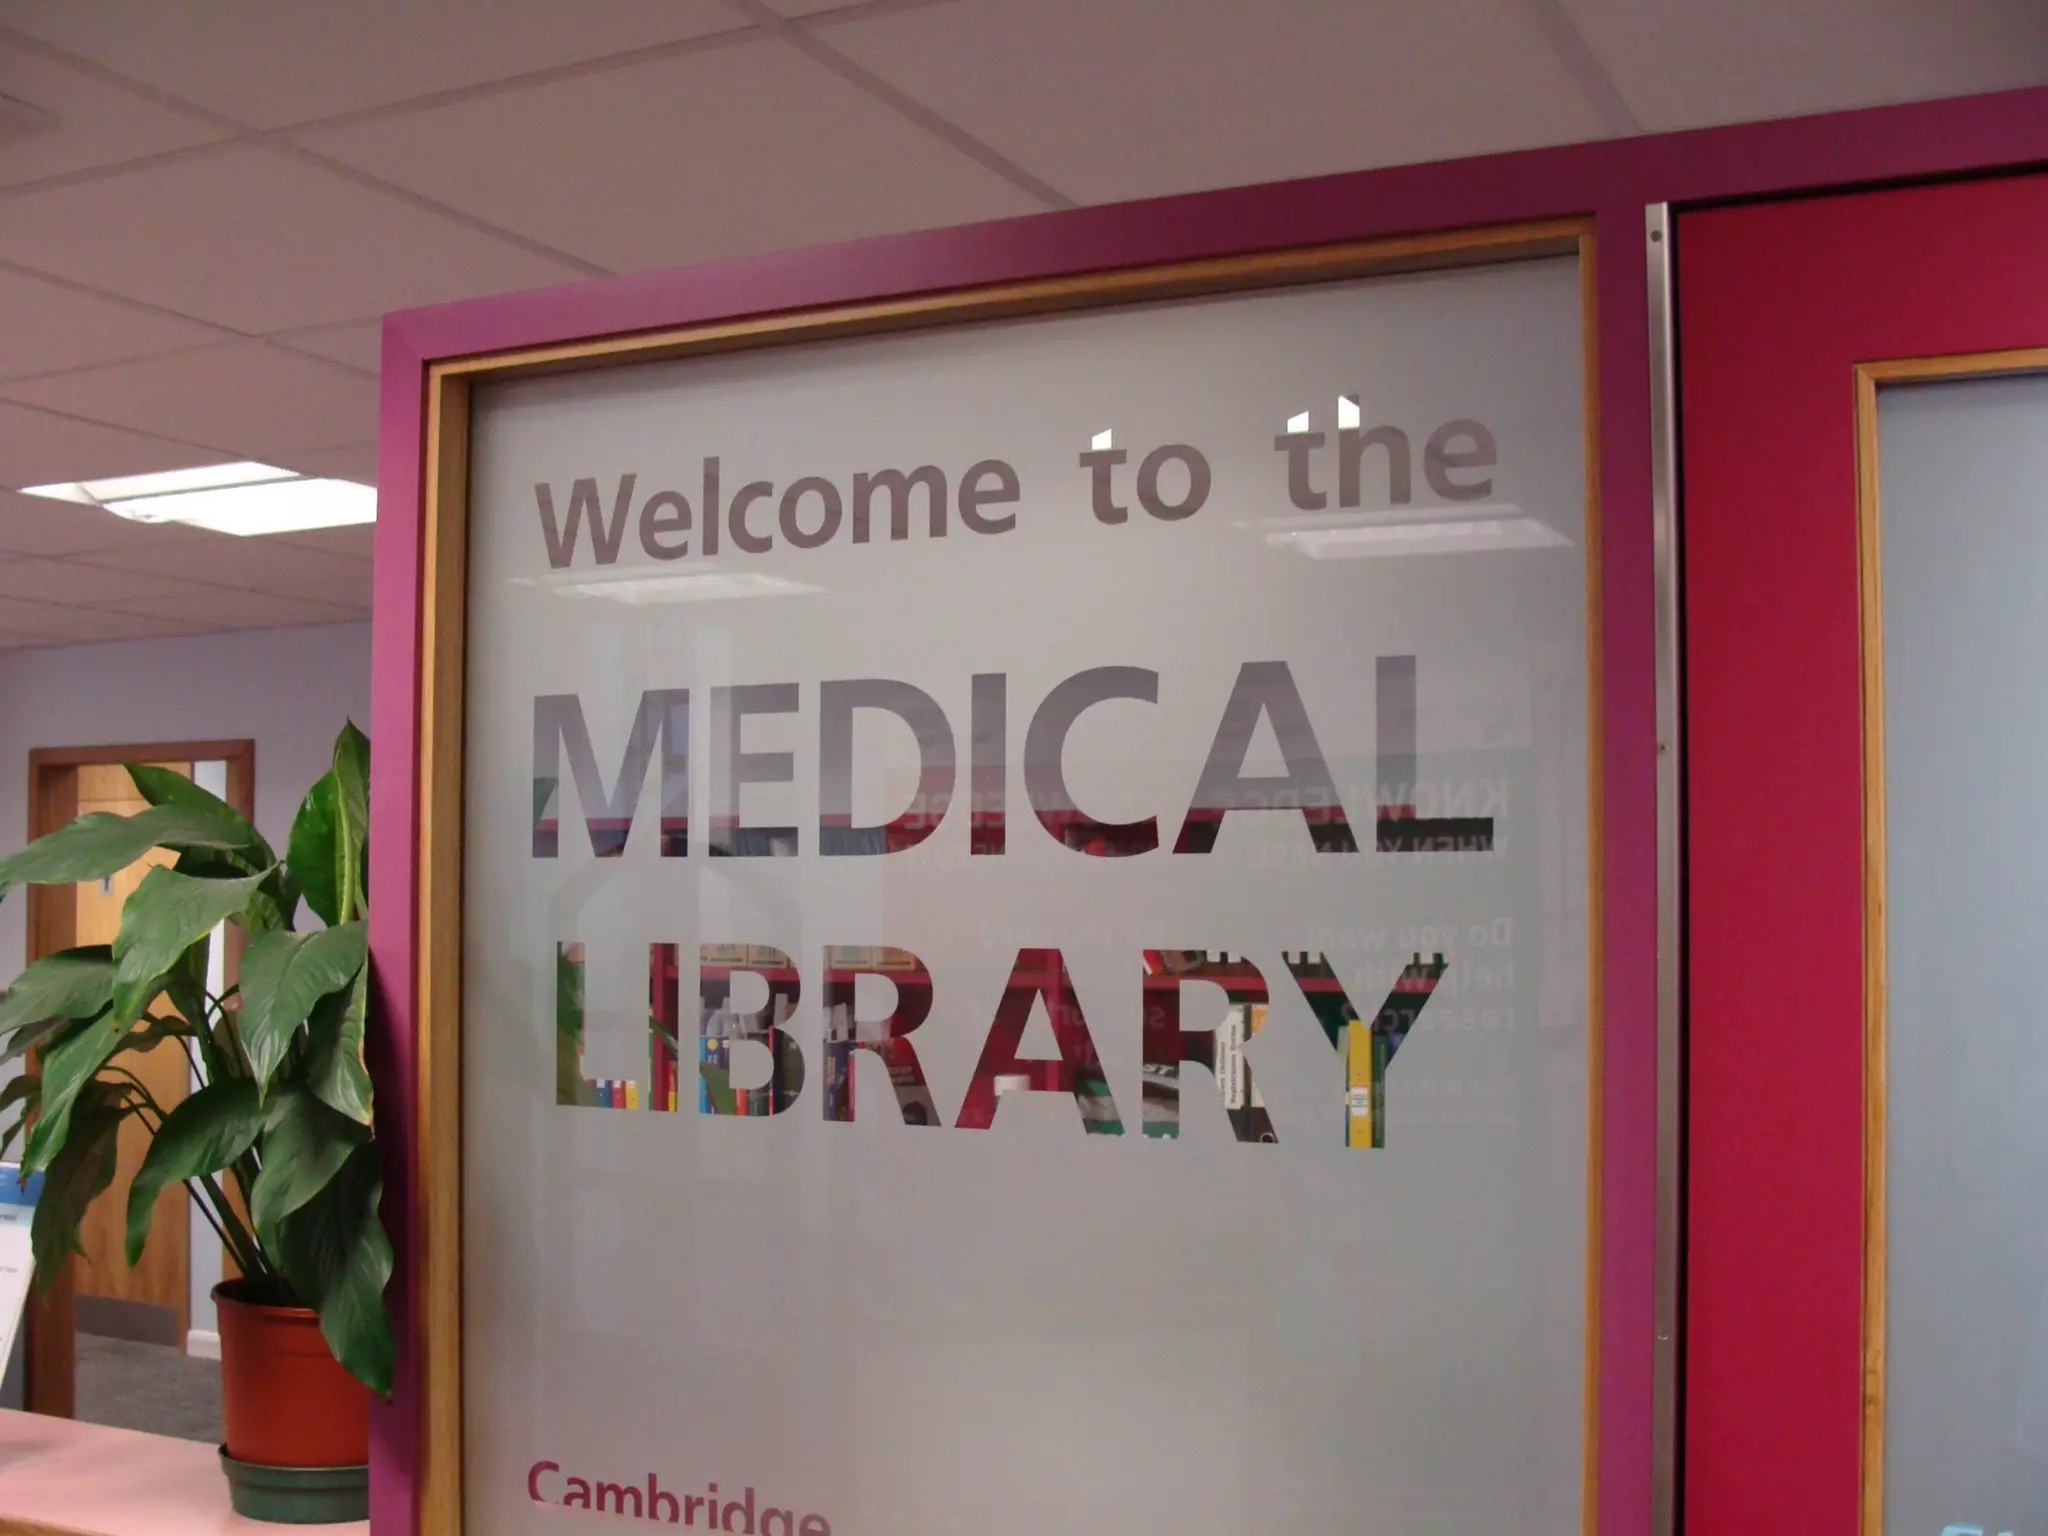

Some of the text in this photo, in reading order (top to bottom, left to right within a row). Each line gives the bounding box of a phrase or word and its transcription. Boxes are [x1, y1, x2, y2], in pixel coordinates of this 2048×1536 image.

[534, 394, 1498, 569] Welcome to the
[531, 655, 1495, 859] MEDICAL
[555, 942, 1450, 1148] LIBRARY
[527, 1460, 832, 1536] Cambridge
